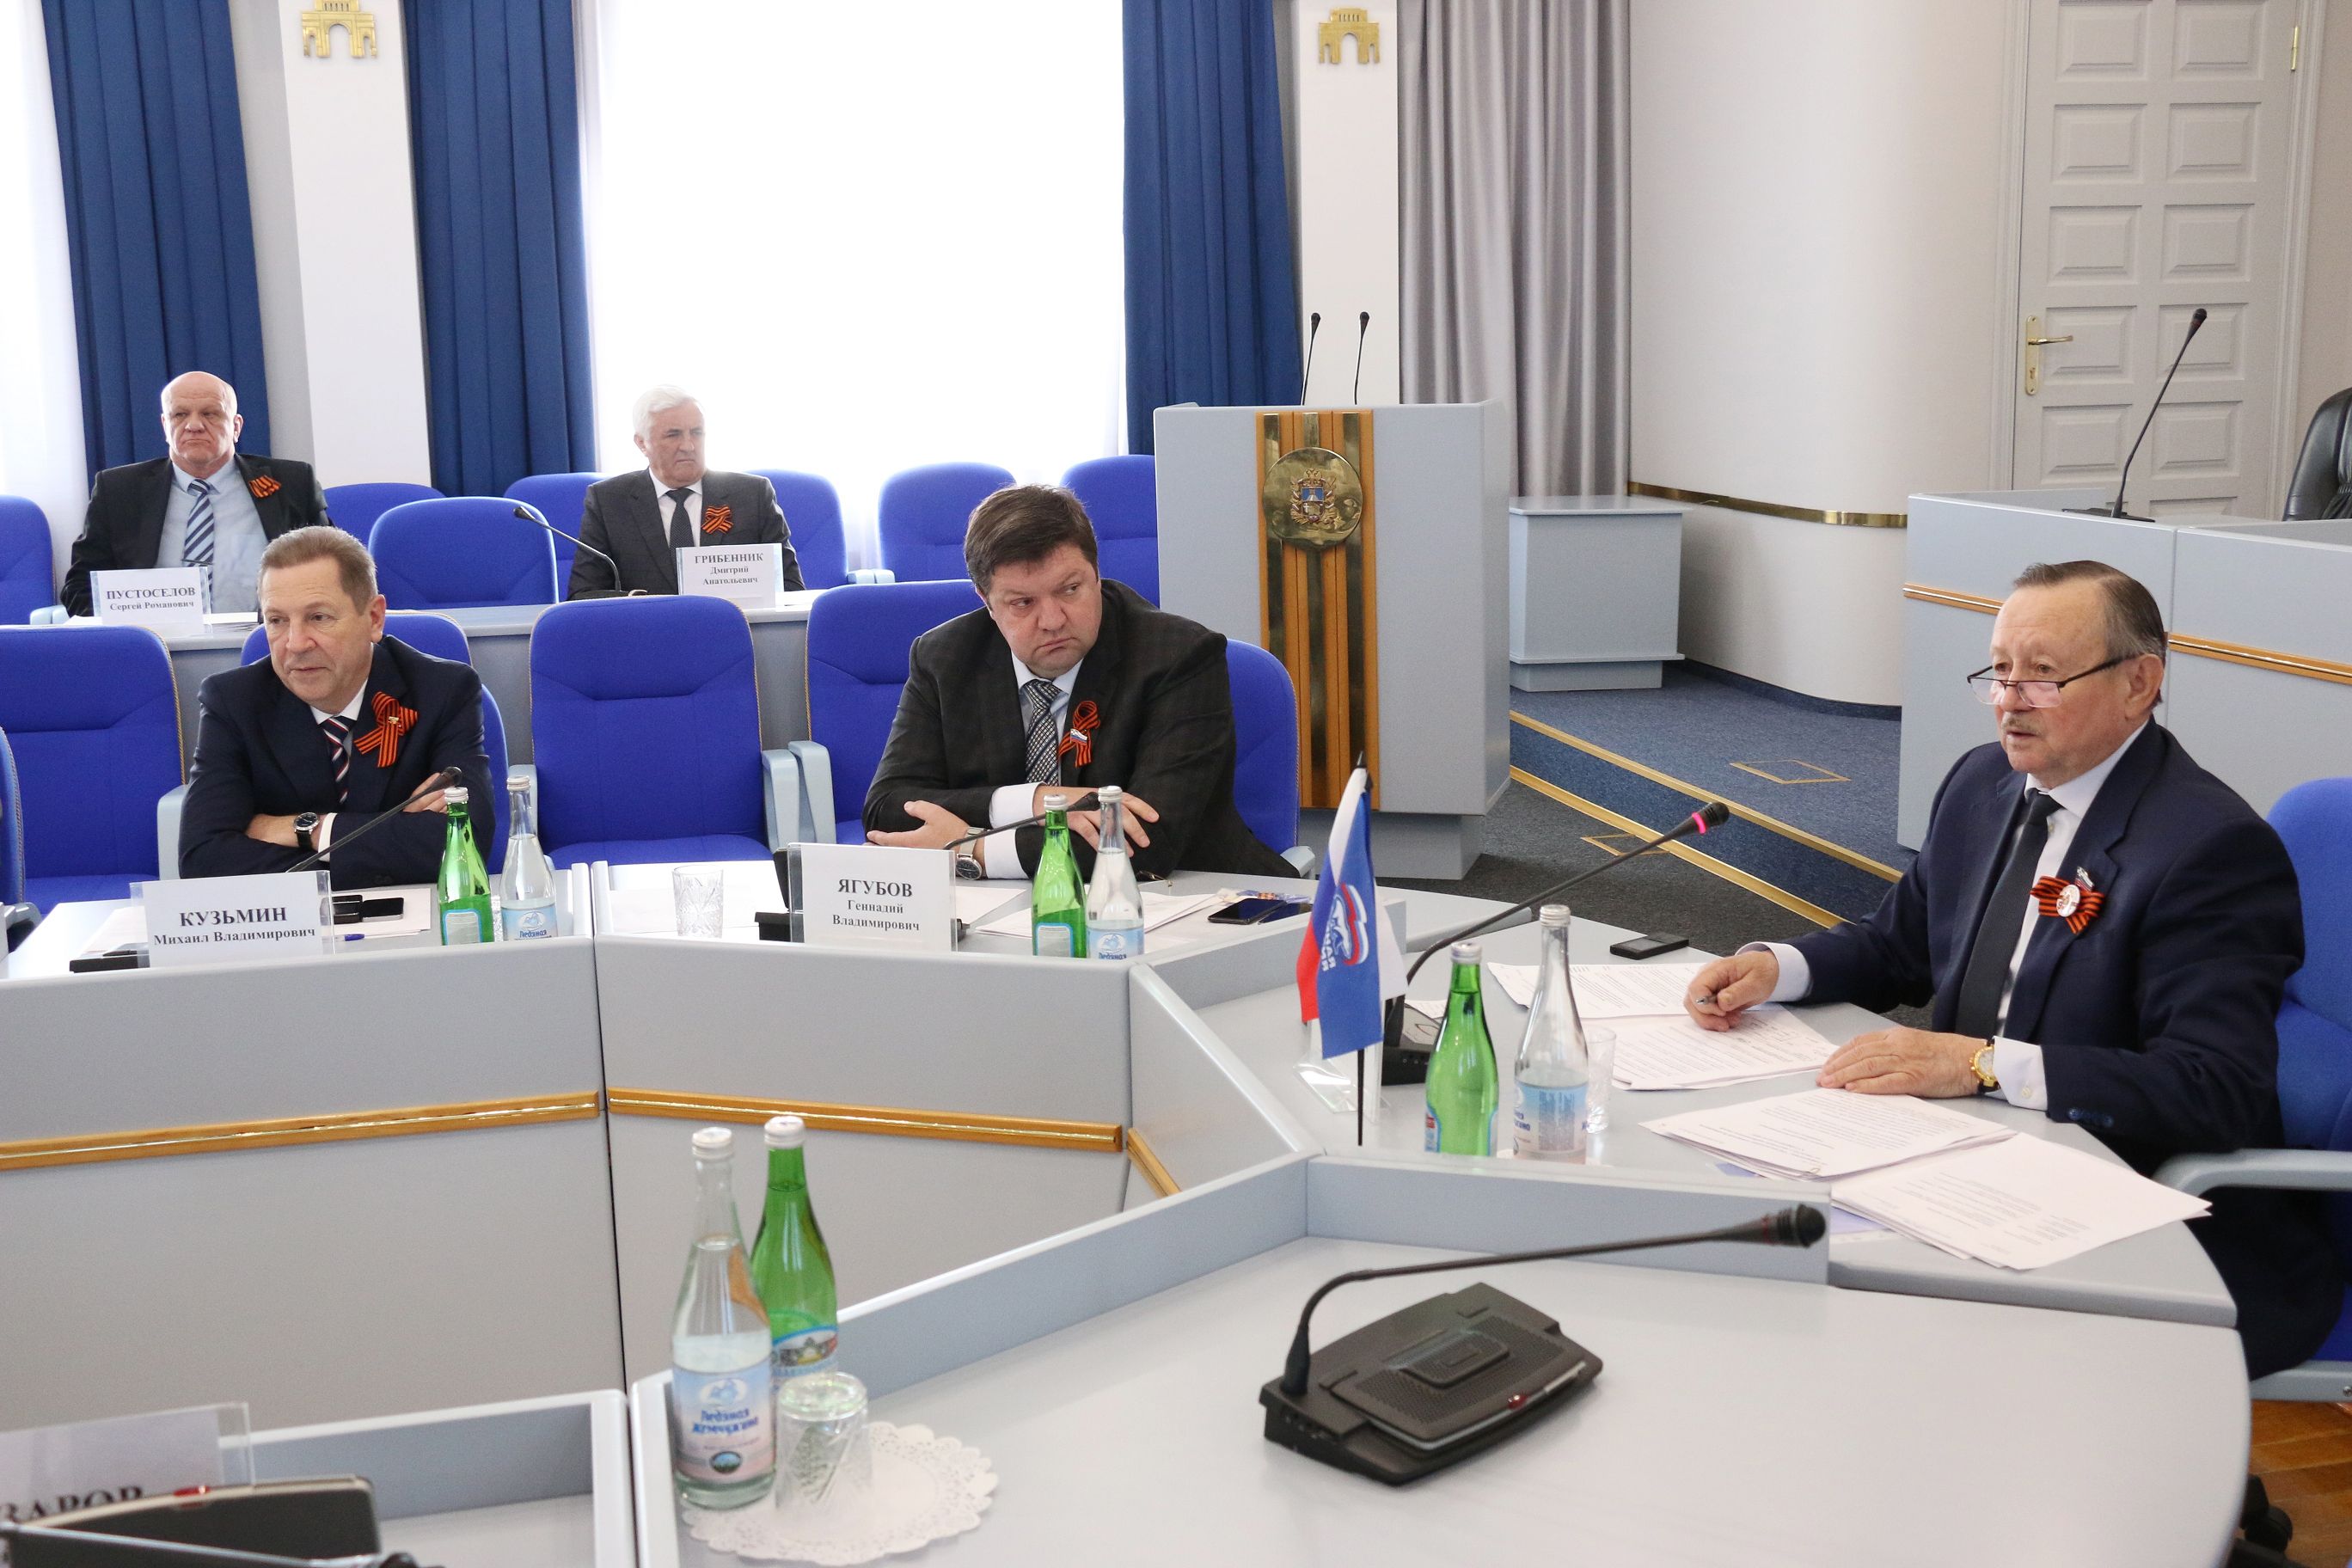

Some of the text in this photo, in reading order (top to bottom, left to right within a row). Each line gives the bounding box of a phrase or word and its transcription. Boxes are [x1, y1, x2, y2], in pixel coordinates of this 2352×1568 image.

[695, 553, 763, 564] ГРИБЕННИК
[710, 567, 749, 575] Дмитрий
[107, 587, 195, 600] ПУСТОСЕЛОВ
[110, 601, 194, 611] Сергей Романович
[838, 879, 913, 897] ЯГУБОВ
[848, 899, 903, 914] Геннадий
[179, 907, 287, 927] КУЗЬМИН
[832, 914, 920, 931] Владимирович
[153, 928, 315, 946] Михаил Владимирович
